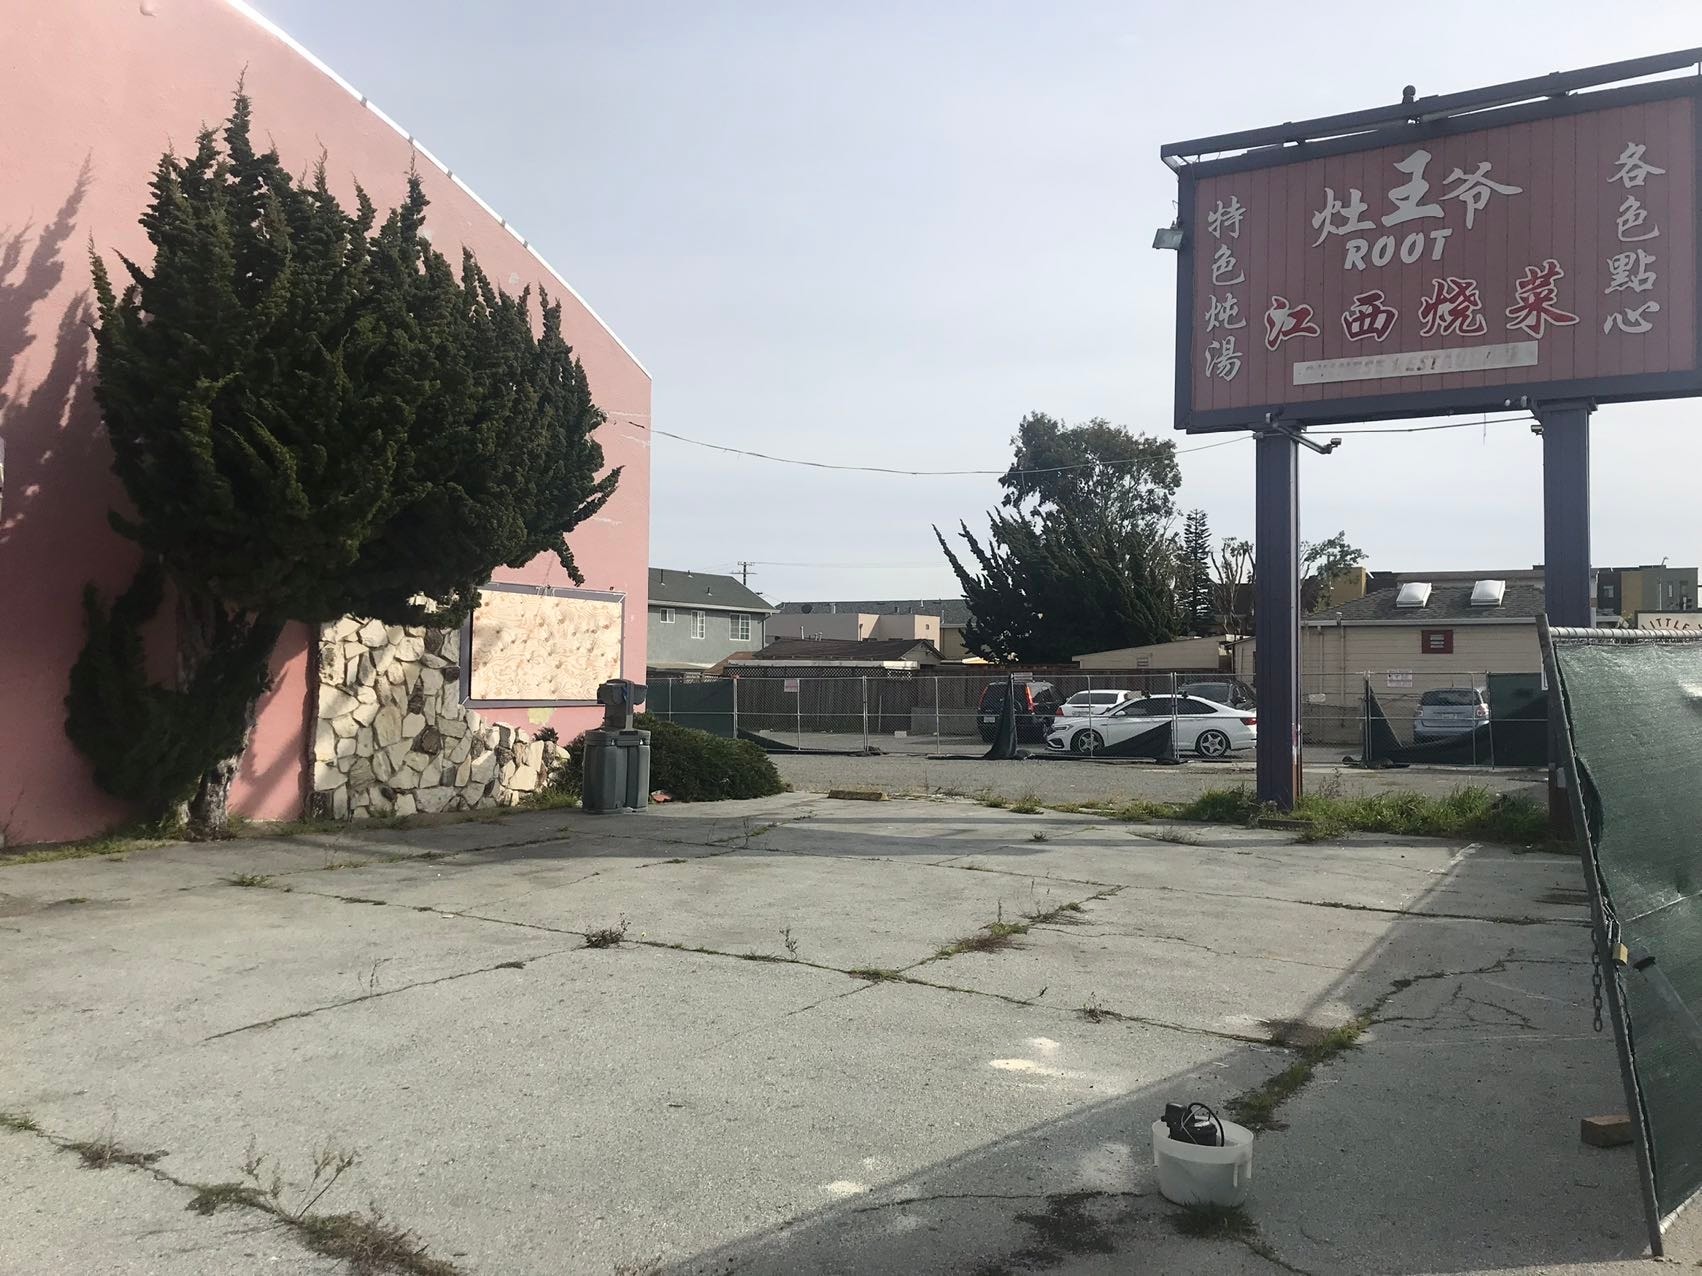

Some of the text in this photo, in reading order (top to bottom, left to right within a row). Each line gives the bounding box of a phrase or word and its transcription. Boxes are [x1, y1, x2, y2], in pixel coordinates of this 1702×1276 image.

[1311, 149, 1523, 248] 灶王爷
[1604, 143, 1666, 335] 各色點心
[1205, 195, 1247, 382] 特色炖湯
[1344, 228, 1453, 271] ROOT
[1264, 259, 1580, 351] 江西烧菜
